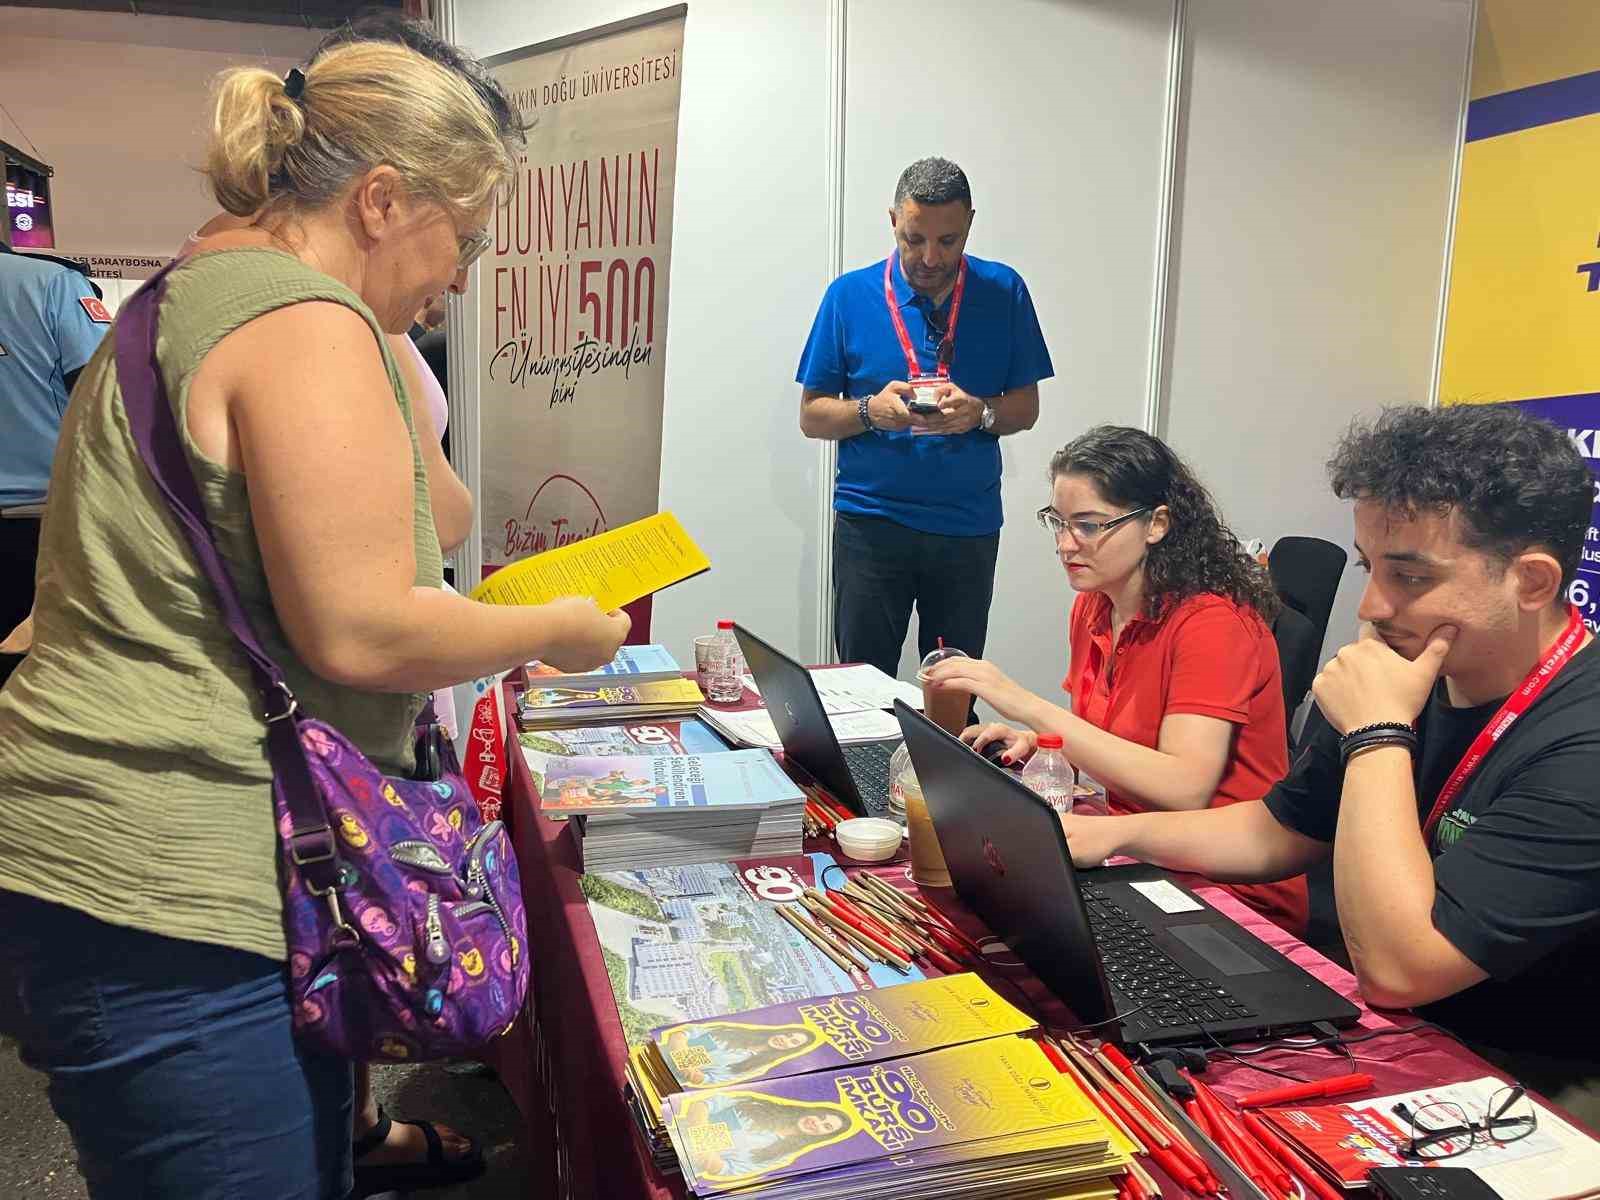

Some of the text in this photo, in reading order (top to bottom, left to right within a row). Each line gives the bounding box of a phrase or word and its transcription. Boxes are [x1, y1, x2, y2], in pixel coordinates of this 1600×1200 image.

[510, 49, 677, 113] AKIN DOĞU ÜNİVERSİTESİ
[495, 148, 659, 256] DÜNYANIN
[91, 256, 162, 269] SARAYBOSNA
[495, 254, 656, 359] EN İYİ 500
[489, 324, 652, 389] Üniversitesinden
[549, 365, 578, 409] biri
[503, 518, 547, 557] Bizim
[816, 1003, 872, 1053] BURS
[856, 1076, 914, 1141] BURS
